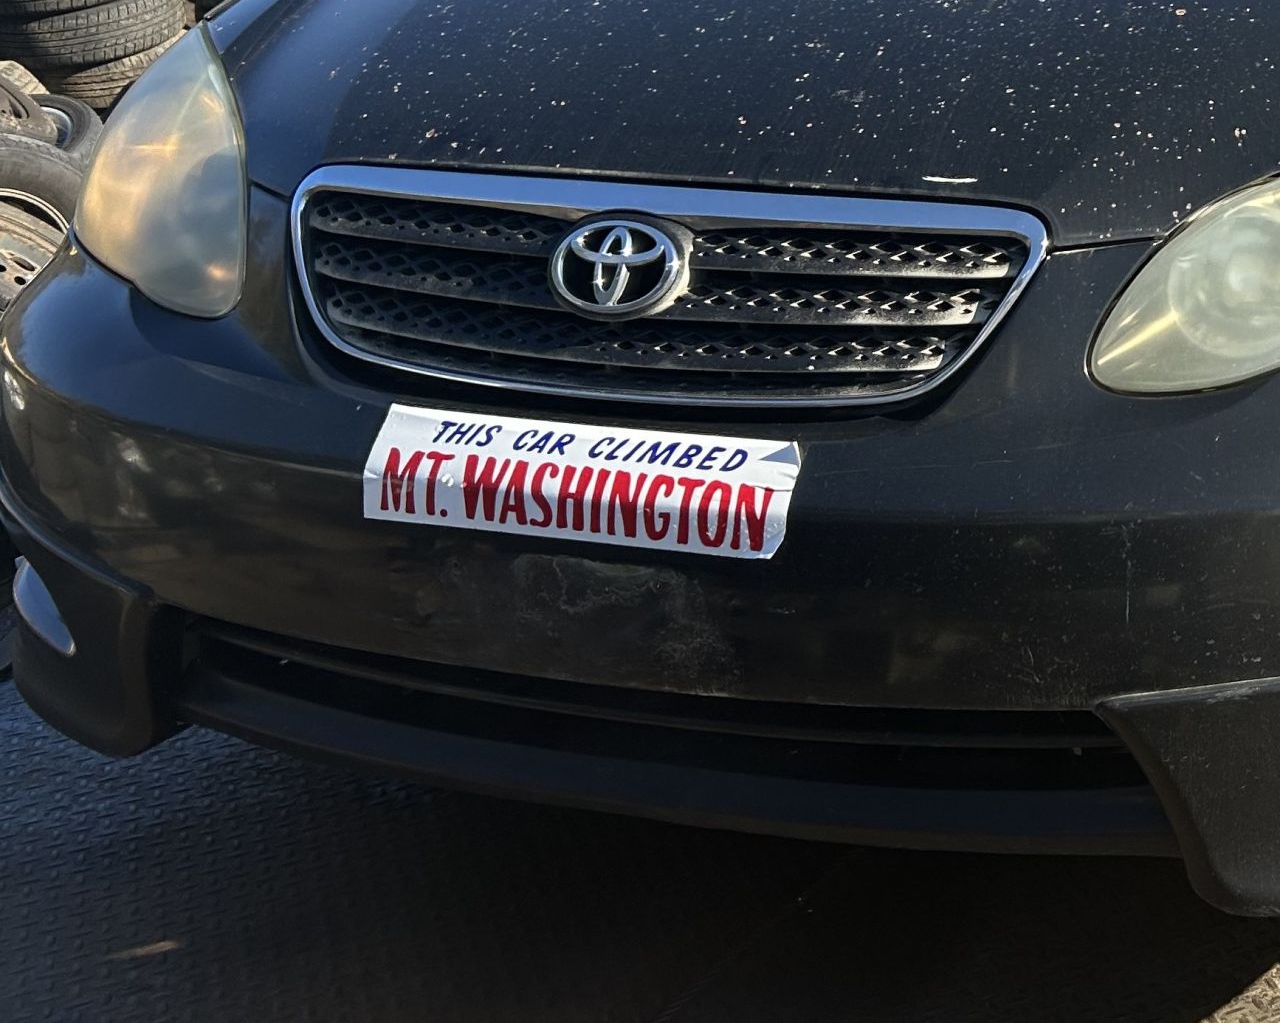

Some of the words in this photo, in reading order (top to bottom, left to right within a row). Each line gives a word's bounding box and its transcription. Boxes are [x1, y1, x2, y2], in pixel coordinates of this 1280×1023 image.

[432, 420, 502, 448] THIS
[512, 431, 576, 456] CAR
[588, 437, 748, 472] CLIMBED
[380, 447, 455, 518] MT.
[461, 453, 775, 552] WASHINGTON
